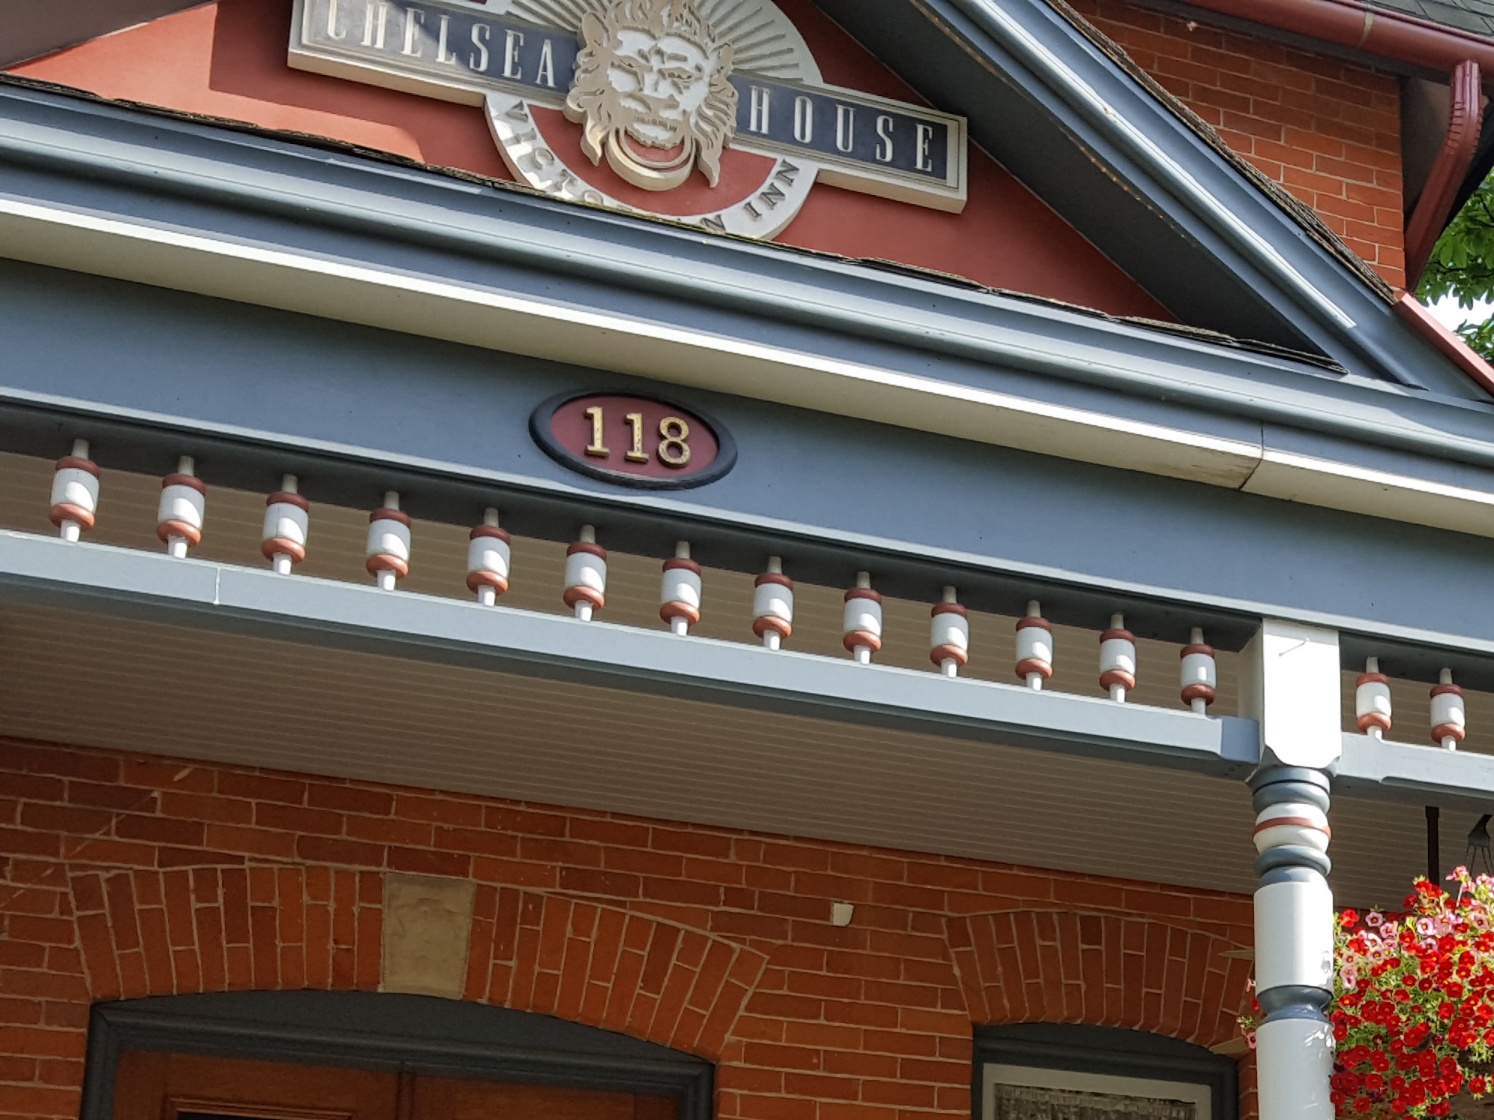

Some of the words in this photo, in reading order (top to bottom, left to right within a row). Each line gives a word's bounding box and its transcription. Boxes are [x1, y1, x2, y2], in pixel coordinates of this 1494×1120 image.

[326, 0, 557, 88] CHELSEA
[748, 85, 933, 171] HOUSE
[506, 100, 727, 233] VICTON
[743, 159, 800, 221] INN
[585, 406, 692, 468] 118
